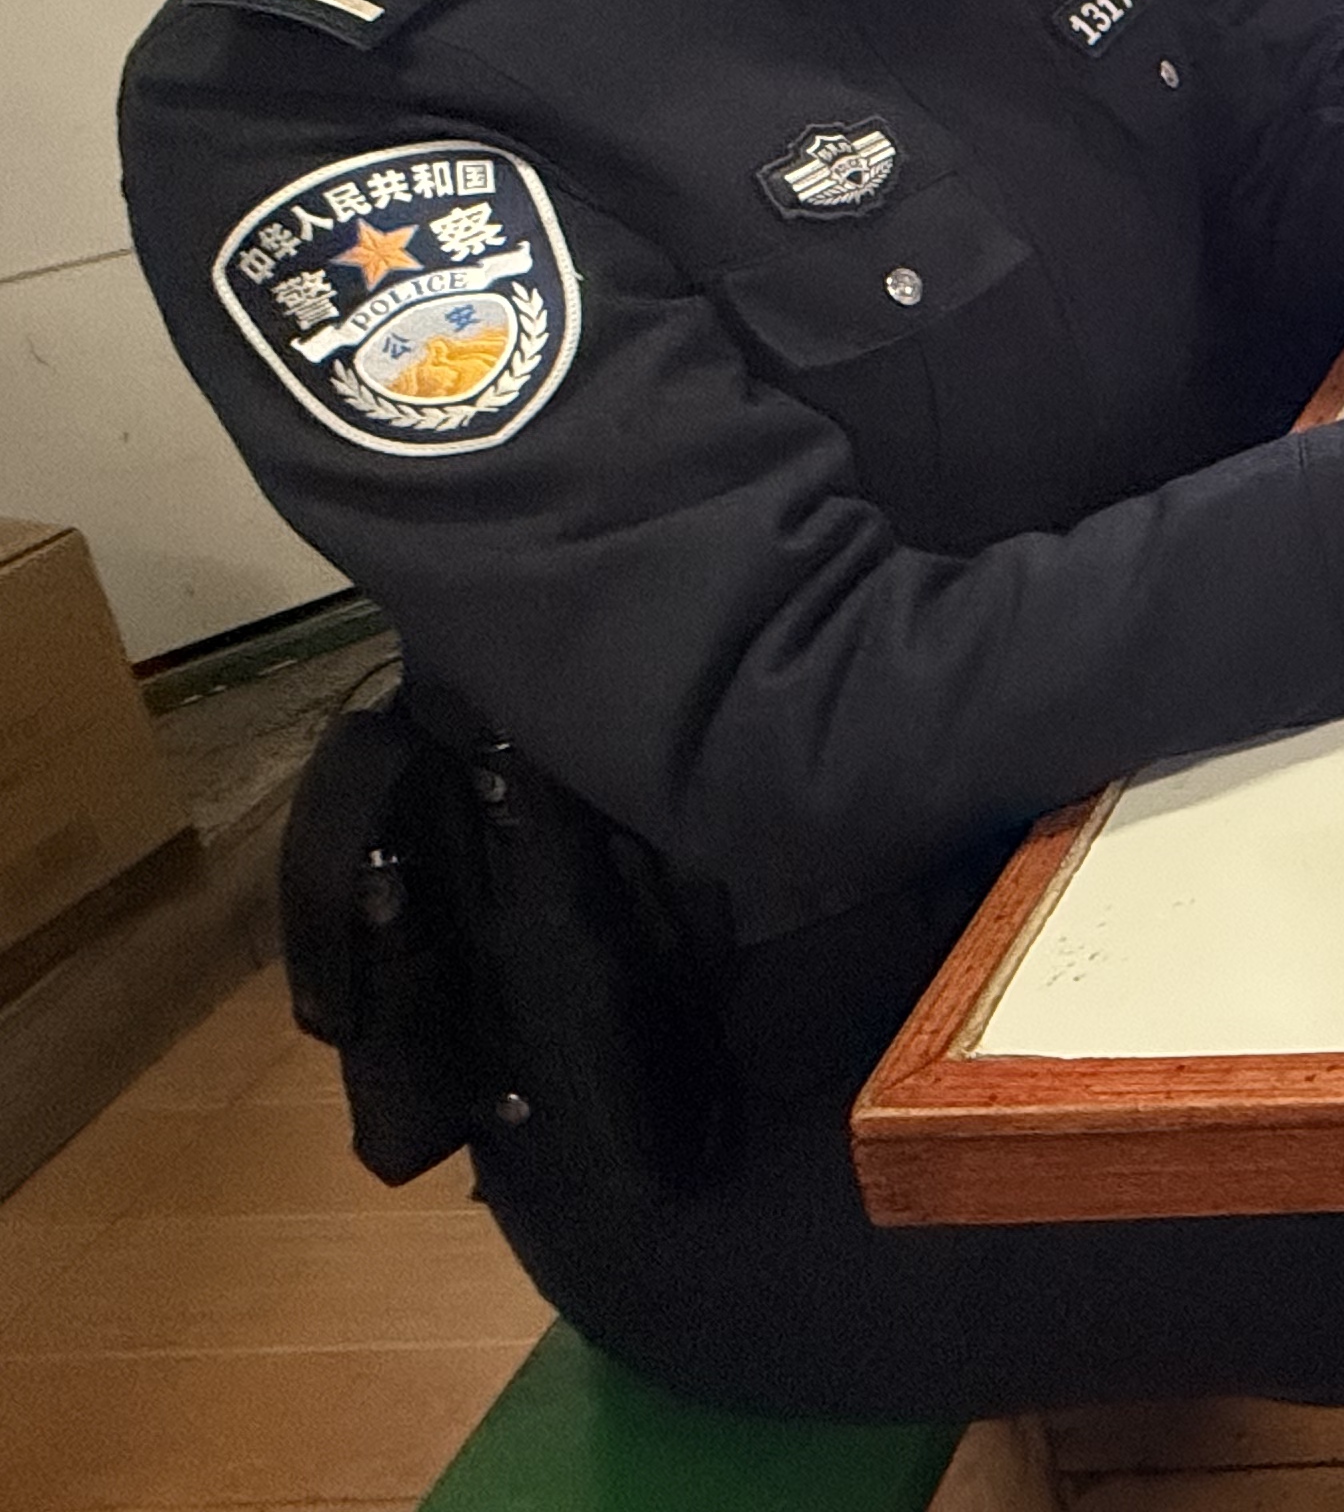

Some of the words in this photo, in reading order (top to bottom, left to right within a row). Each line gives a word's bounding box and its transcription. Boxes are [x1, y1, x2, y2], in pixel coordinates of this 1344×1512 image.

[236, 159, 497, 285] 中华人民共和国
[350, 270, 468, 332] POLICE
